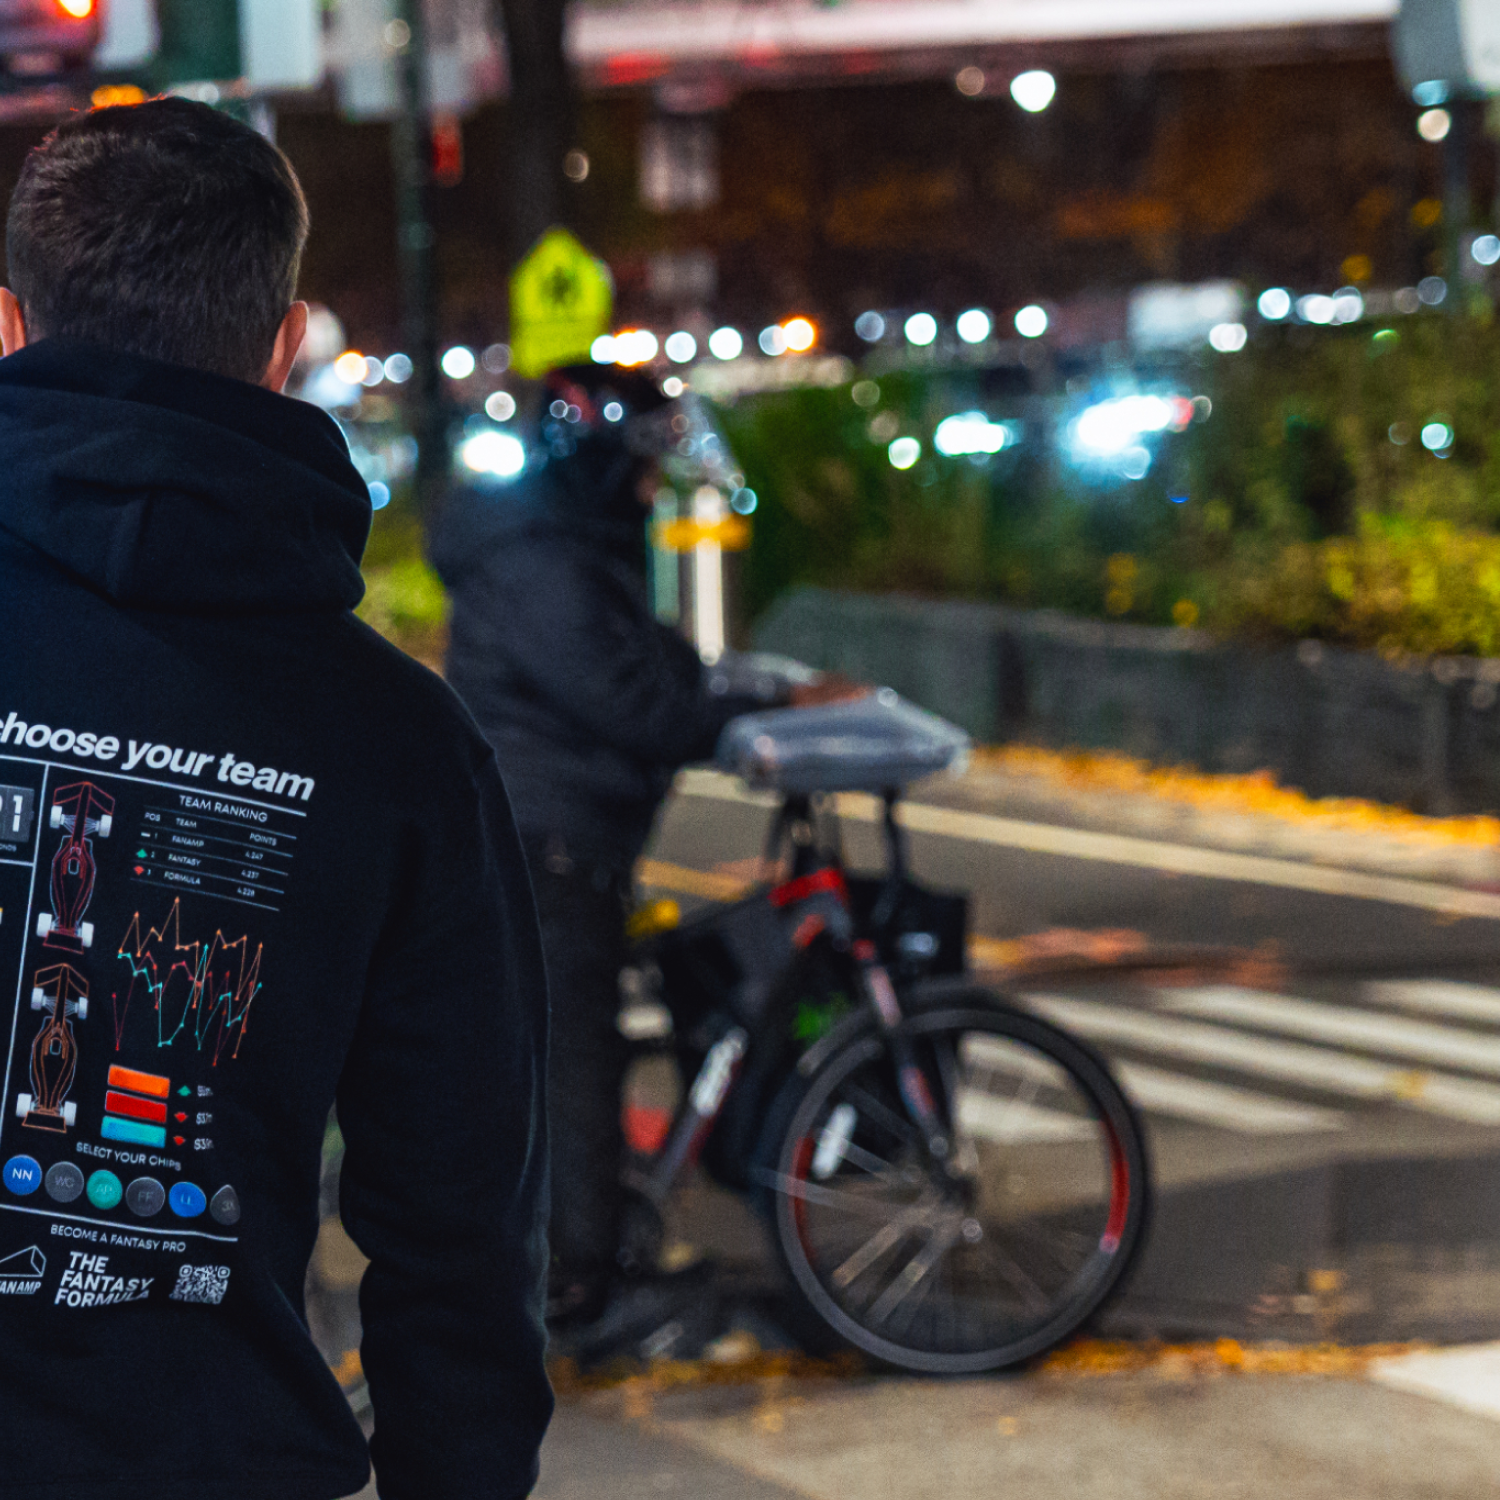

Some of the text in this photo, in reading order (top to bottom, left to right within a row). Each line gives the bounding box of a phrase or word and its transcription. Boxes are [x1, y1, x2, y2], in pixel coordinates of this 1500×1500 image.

[121, 739, 215, 777] your
[216, 752, 316, 801] team
[179, 794, 268, 823] TEAM RANKING
[176, 817, 197, 828] TEAM
[172, 835, 205, 847] FANAMP
[250, 832, 277, 846] POINTS
[168, 853, 201, 867] FANTASY
[164, 871, 201, 885] FORMULA
[76, 1141, 182, 1171] SELECT YOUR CHIPS
[12, 1167, 33, 1182] NN
[50, 1224, 187, 1252] BECOME A FANTASY PRO
[69, 1250, 109, 1274] THE
[60, 1269, 155, 1293] FANTASY
